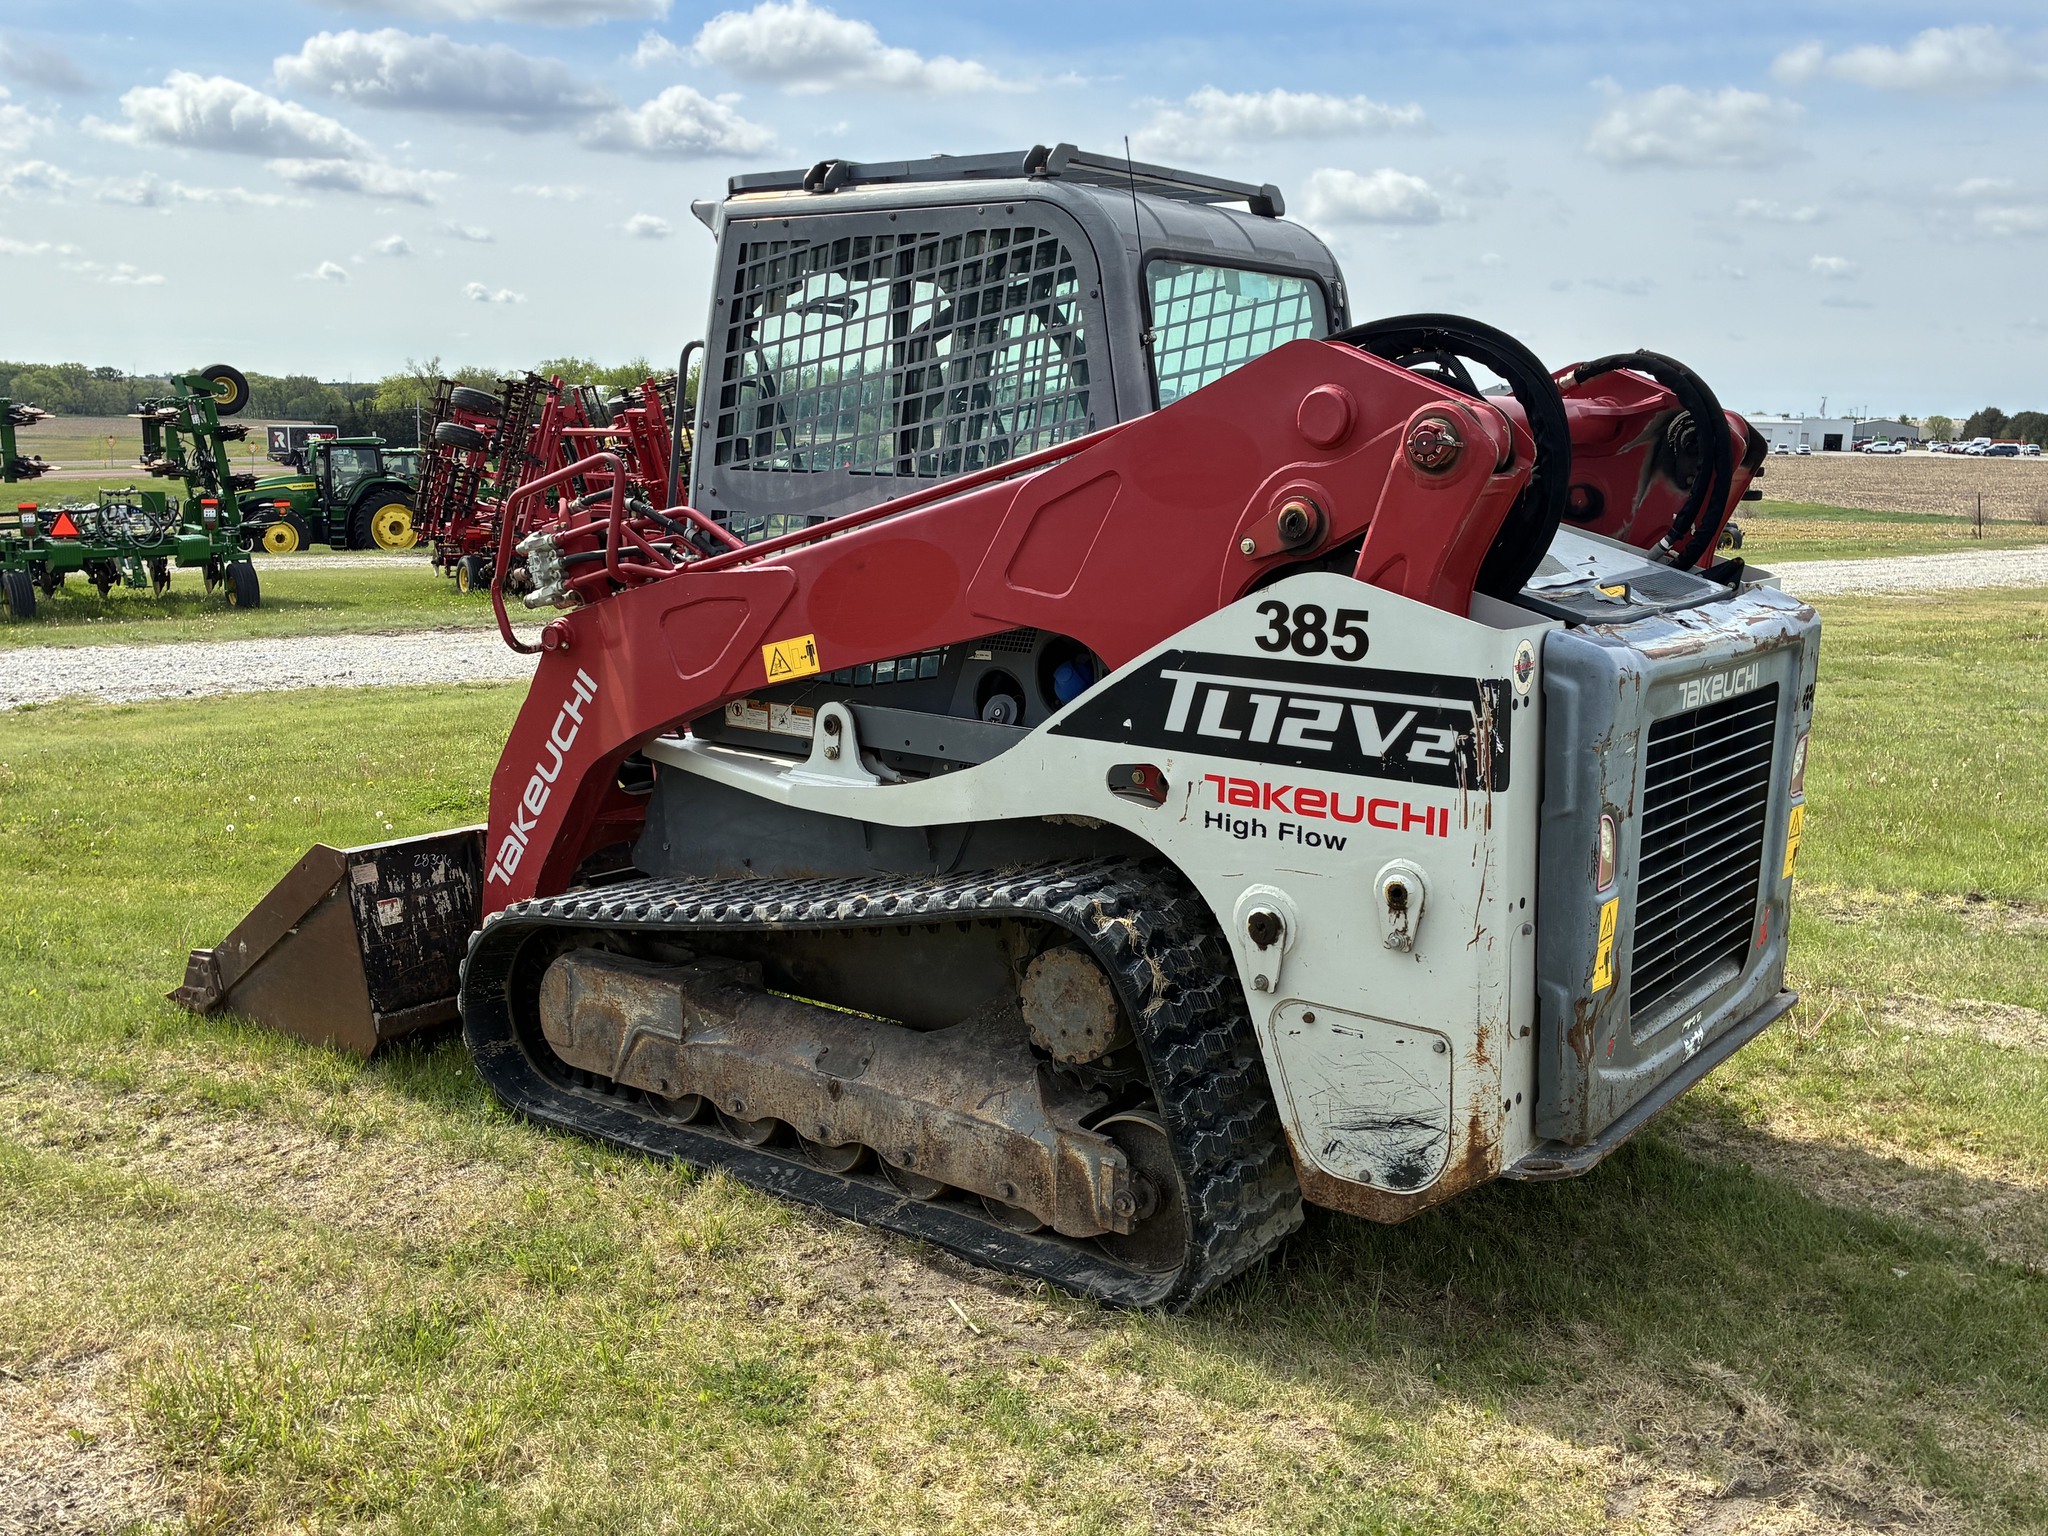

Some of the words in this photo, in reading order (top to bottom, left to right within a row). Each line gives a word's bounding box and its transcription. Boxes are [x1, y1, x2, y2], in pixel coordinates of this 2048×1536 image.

[1255, 600, 1370, 662] 385
[1160, 669, 1468, 766] TL12V2
[1204, 811, 1267, 839] High
[1278, 822, 1348, 851] Flow
